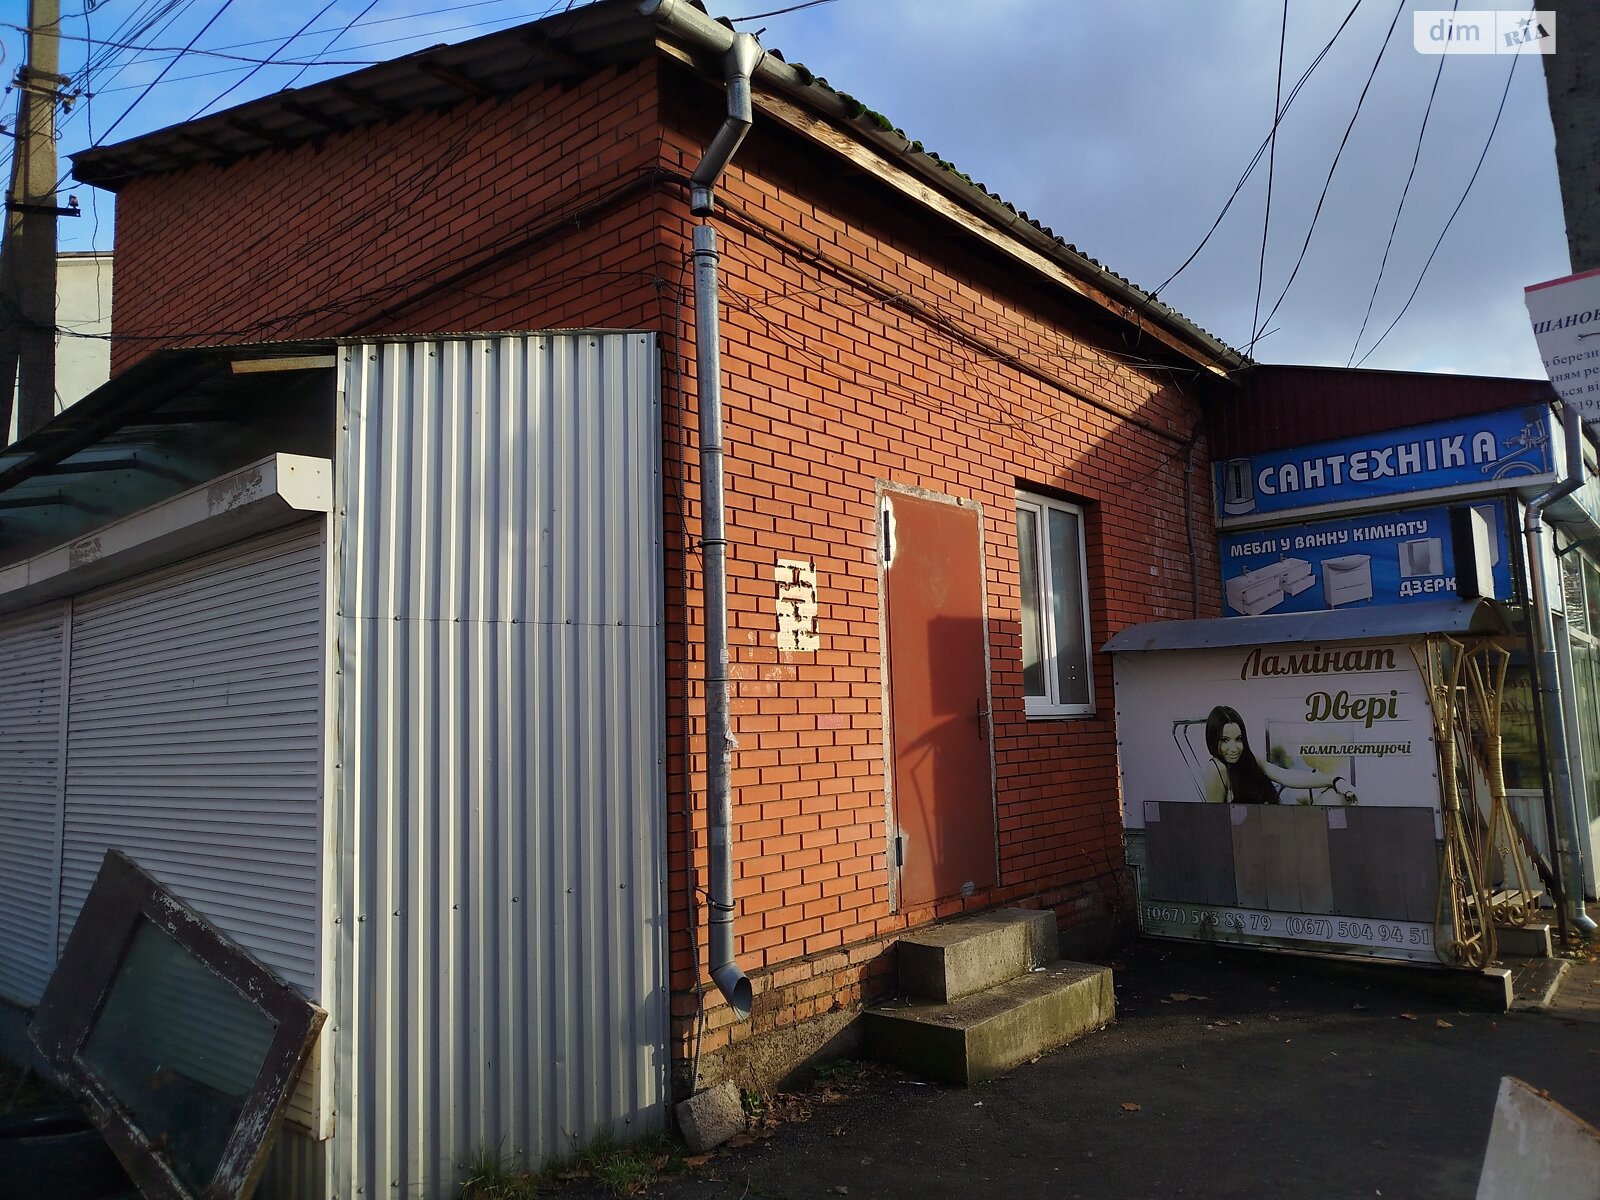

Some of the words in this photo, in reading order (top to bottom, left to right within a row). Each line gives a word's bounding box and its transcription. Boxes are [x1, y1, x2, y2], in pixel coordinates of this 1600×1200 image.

[1257, 430, 1497, 495] САНТЕХНІКА
[1230, 542, 1276, 558] МЕБЛІ
[1280, 537, 1291, 551] У
[1294, 529, 1349, 550] ВАННУ
[1353, 519, 1428, 541] КІМНАТУ
[1240, 646, 1396, 681] Ламінат
[1305, 689, 1398, 729] Двері
[1299, 740, 1412, 758] комплектуючі
[1146, 906, 1187, 925] (067)
[1224, 912, 1247, 929] 88
[1250, 914, 1272, 931] 79
[1285, 916, 1333, 939] (067)
[1338, 921, 1374, 940] 504
[1378, 924, 1403, 943] 94
[1409, 927, 1430, 945] 51
